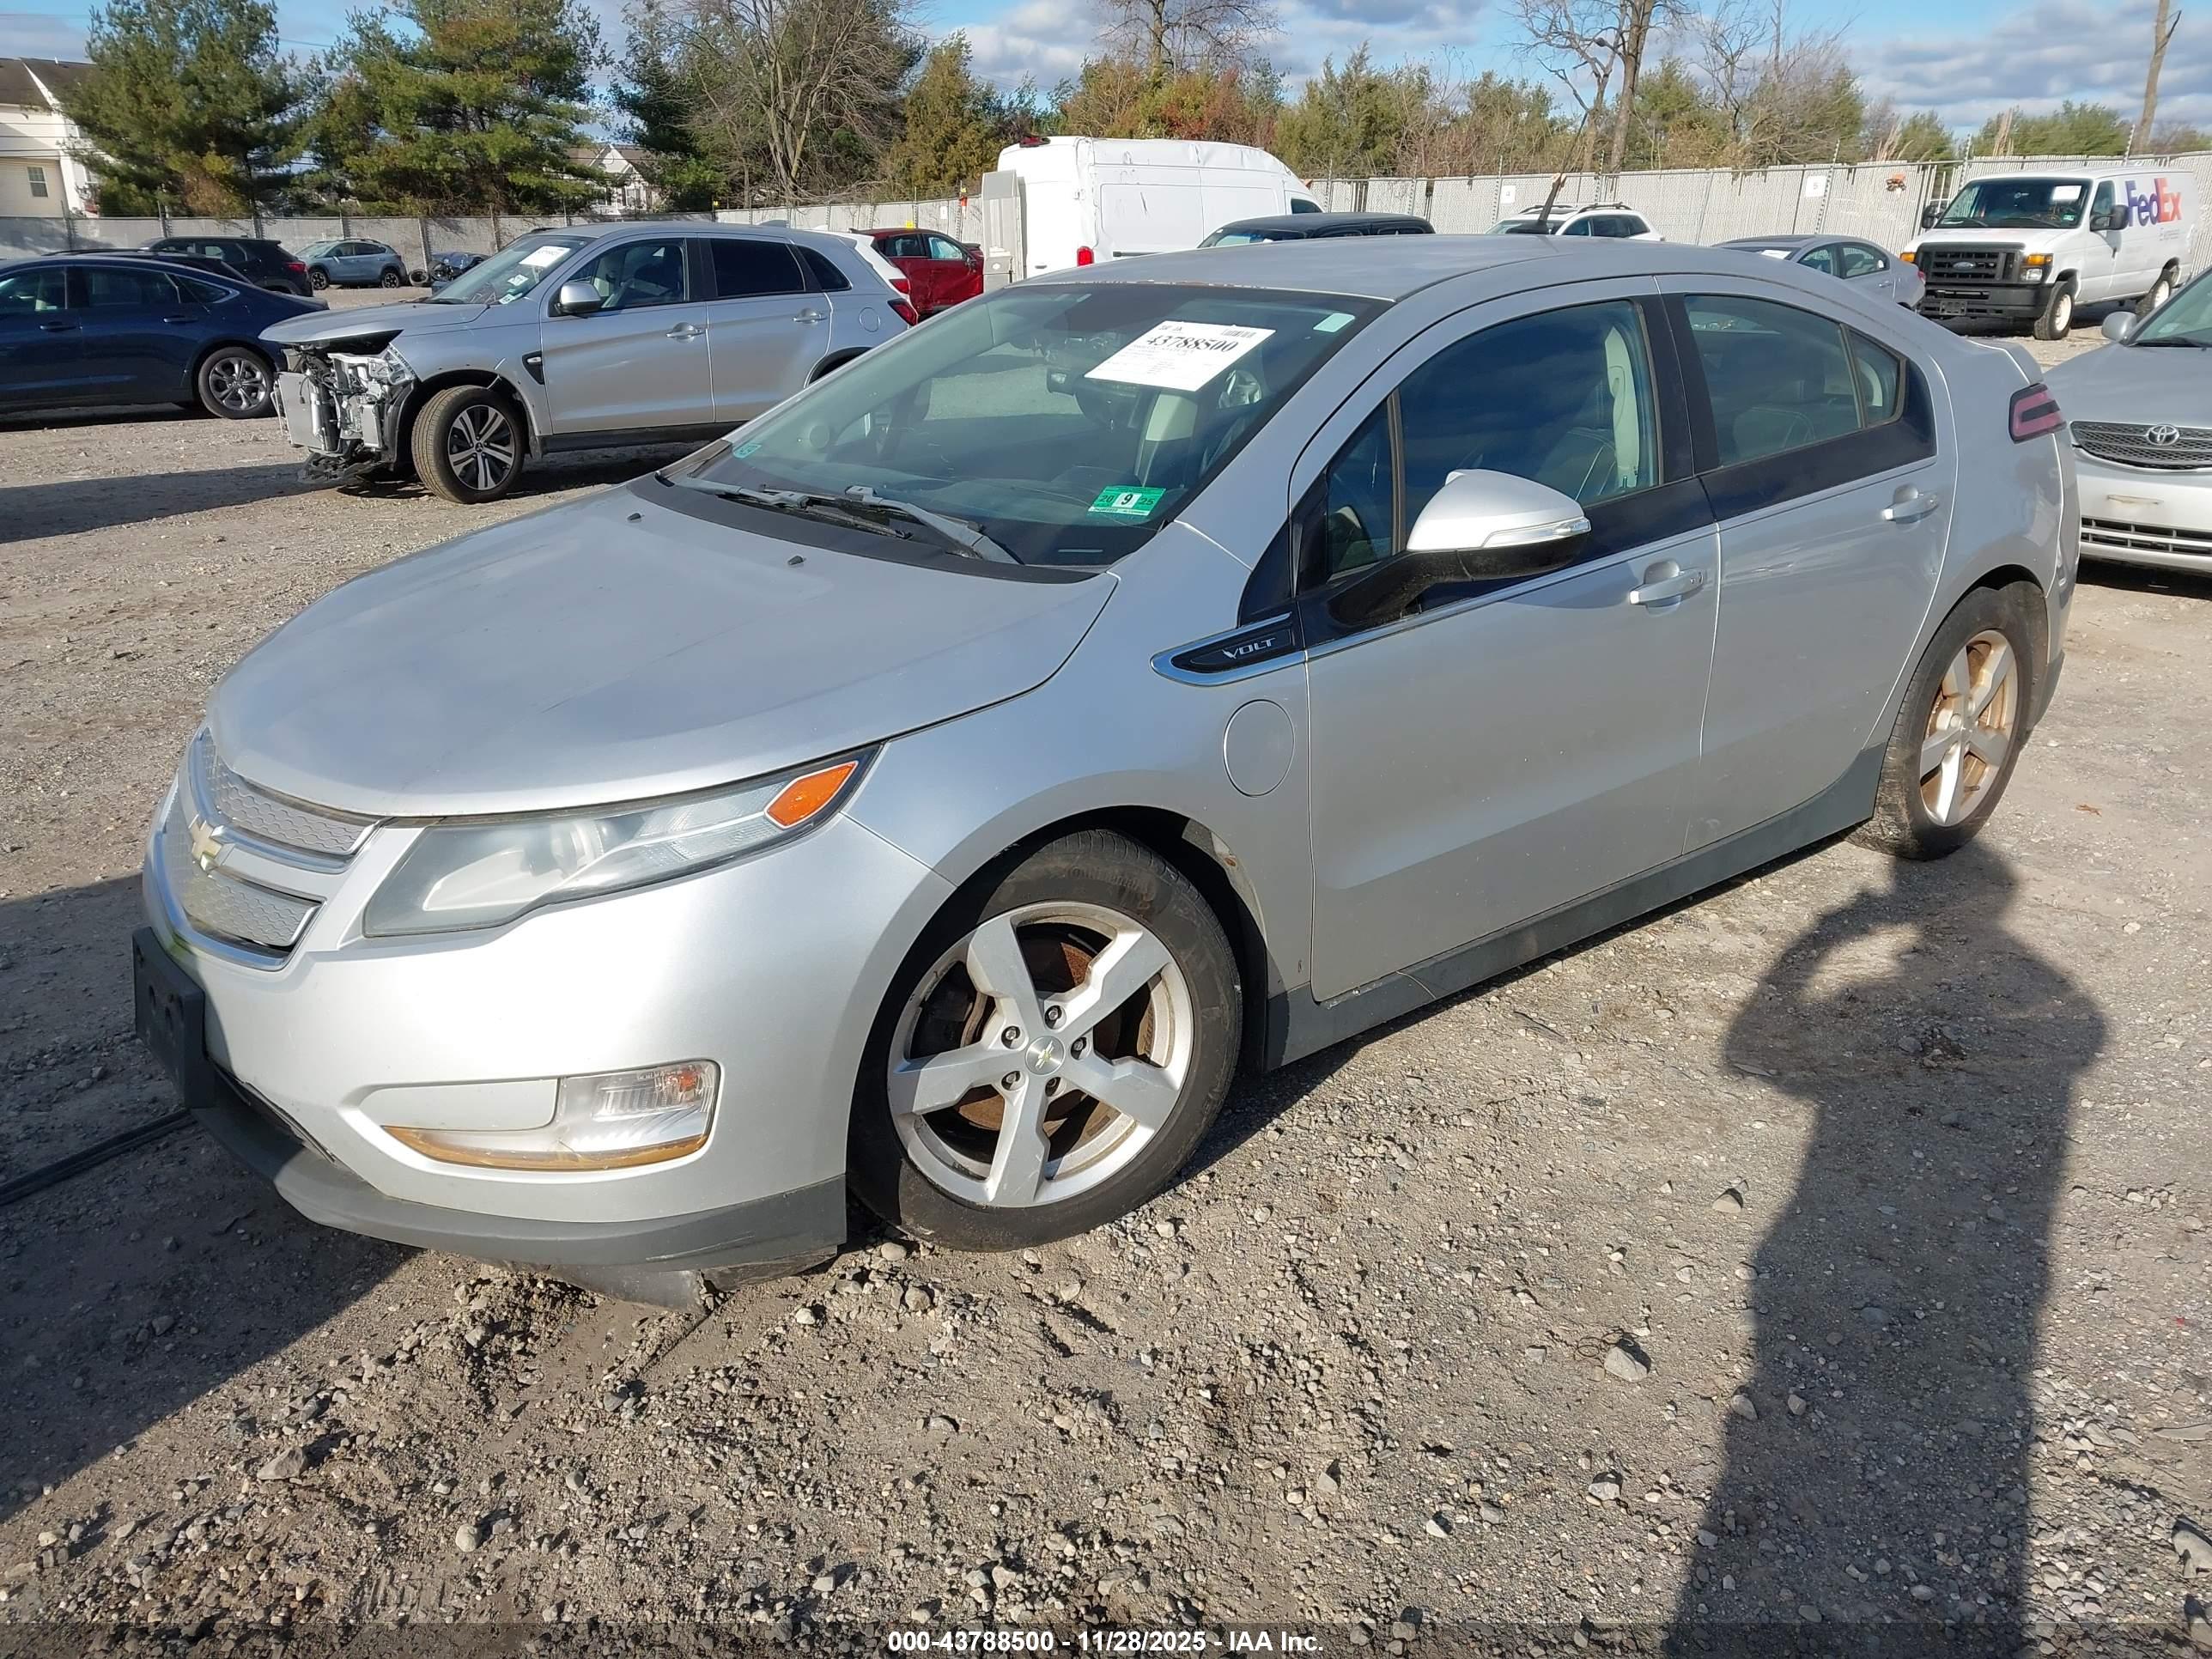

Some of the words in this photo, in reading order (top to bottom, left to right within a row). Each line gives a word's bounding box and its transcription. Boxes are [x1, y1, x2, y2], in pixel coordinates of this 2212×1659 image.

[2125, 178, 2182, 227] FedEx
[1146, 335, 1238, 353] 43788500
[1099, 495, 1114, 503] 20
[1121, 493, 1133, 505] 9
[1139, 497, 1154, 506] 25
[1222, 637, 1276, 659] VOLT
